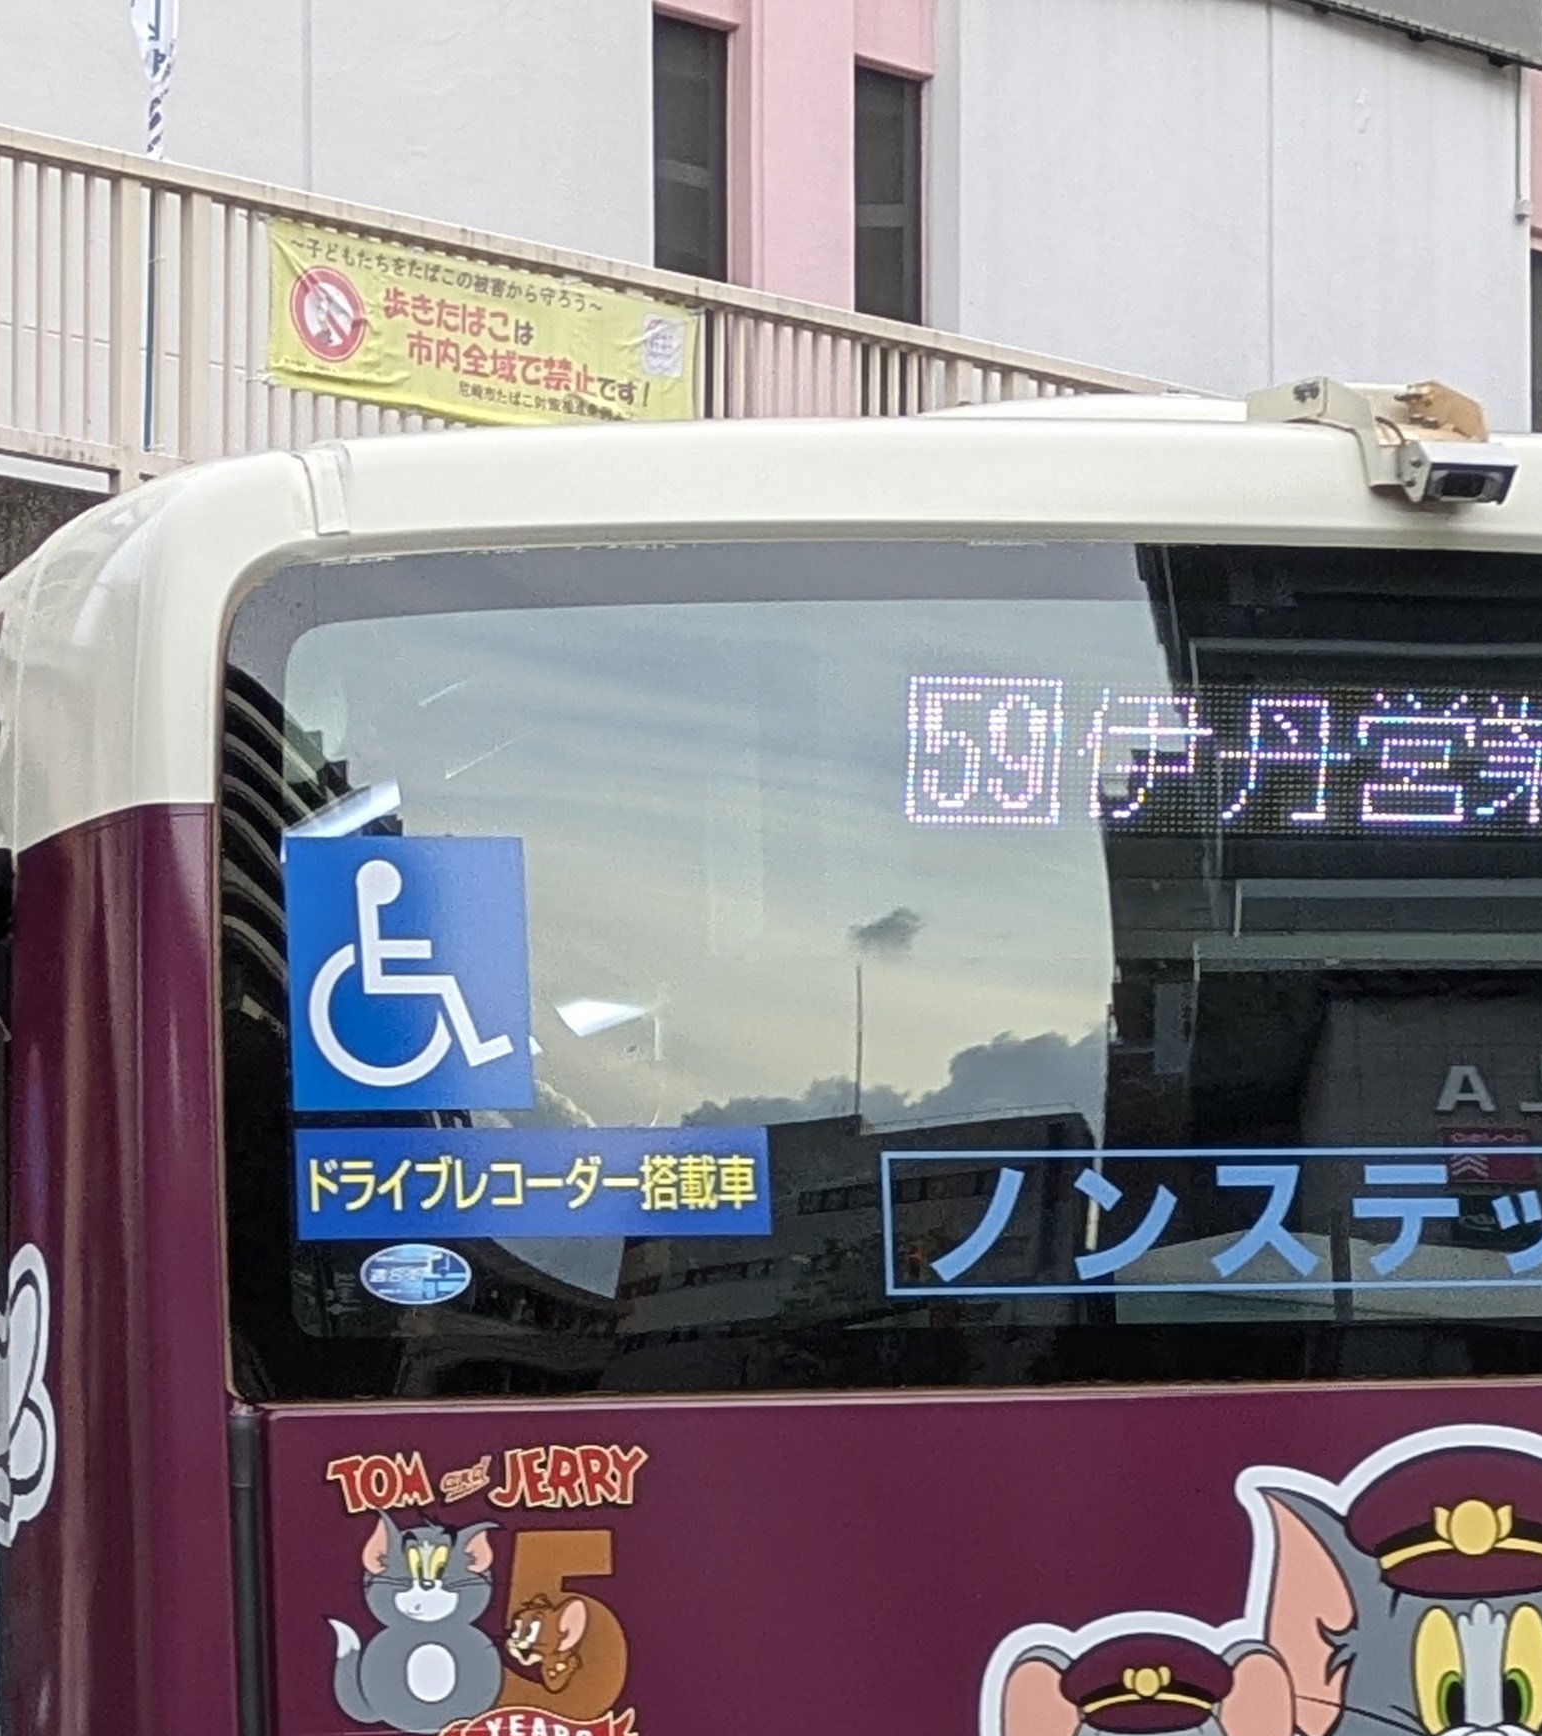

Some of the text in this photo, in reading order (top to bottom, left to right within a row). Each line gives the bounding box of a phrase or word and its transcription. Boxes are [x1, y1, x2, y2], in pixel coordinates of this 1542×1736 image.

[383, 287, 534, 346] 歩きたばこは
[407, 331, 651, 408] 市内全域で禁止です!
[922, 692, 1047, 809] 59
[308, 1154, 757, 1213] ドライブレコーダー搭載車
[326, 1445, 649, 1513] TOM and JERRY
